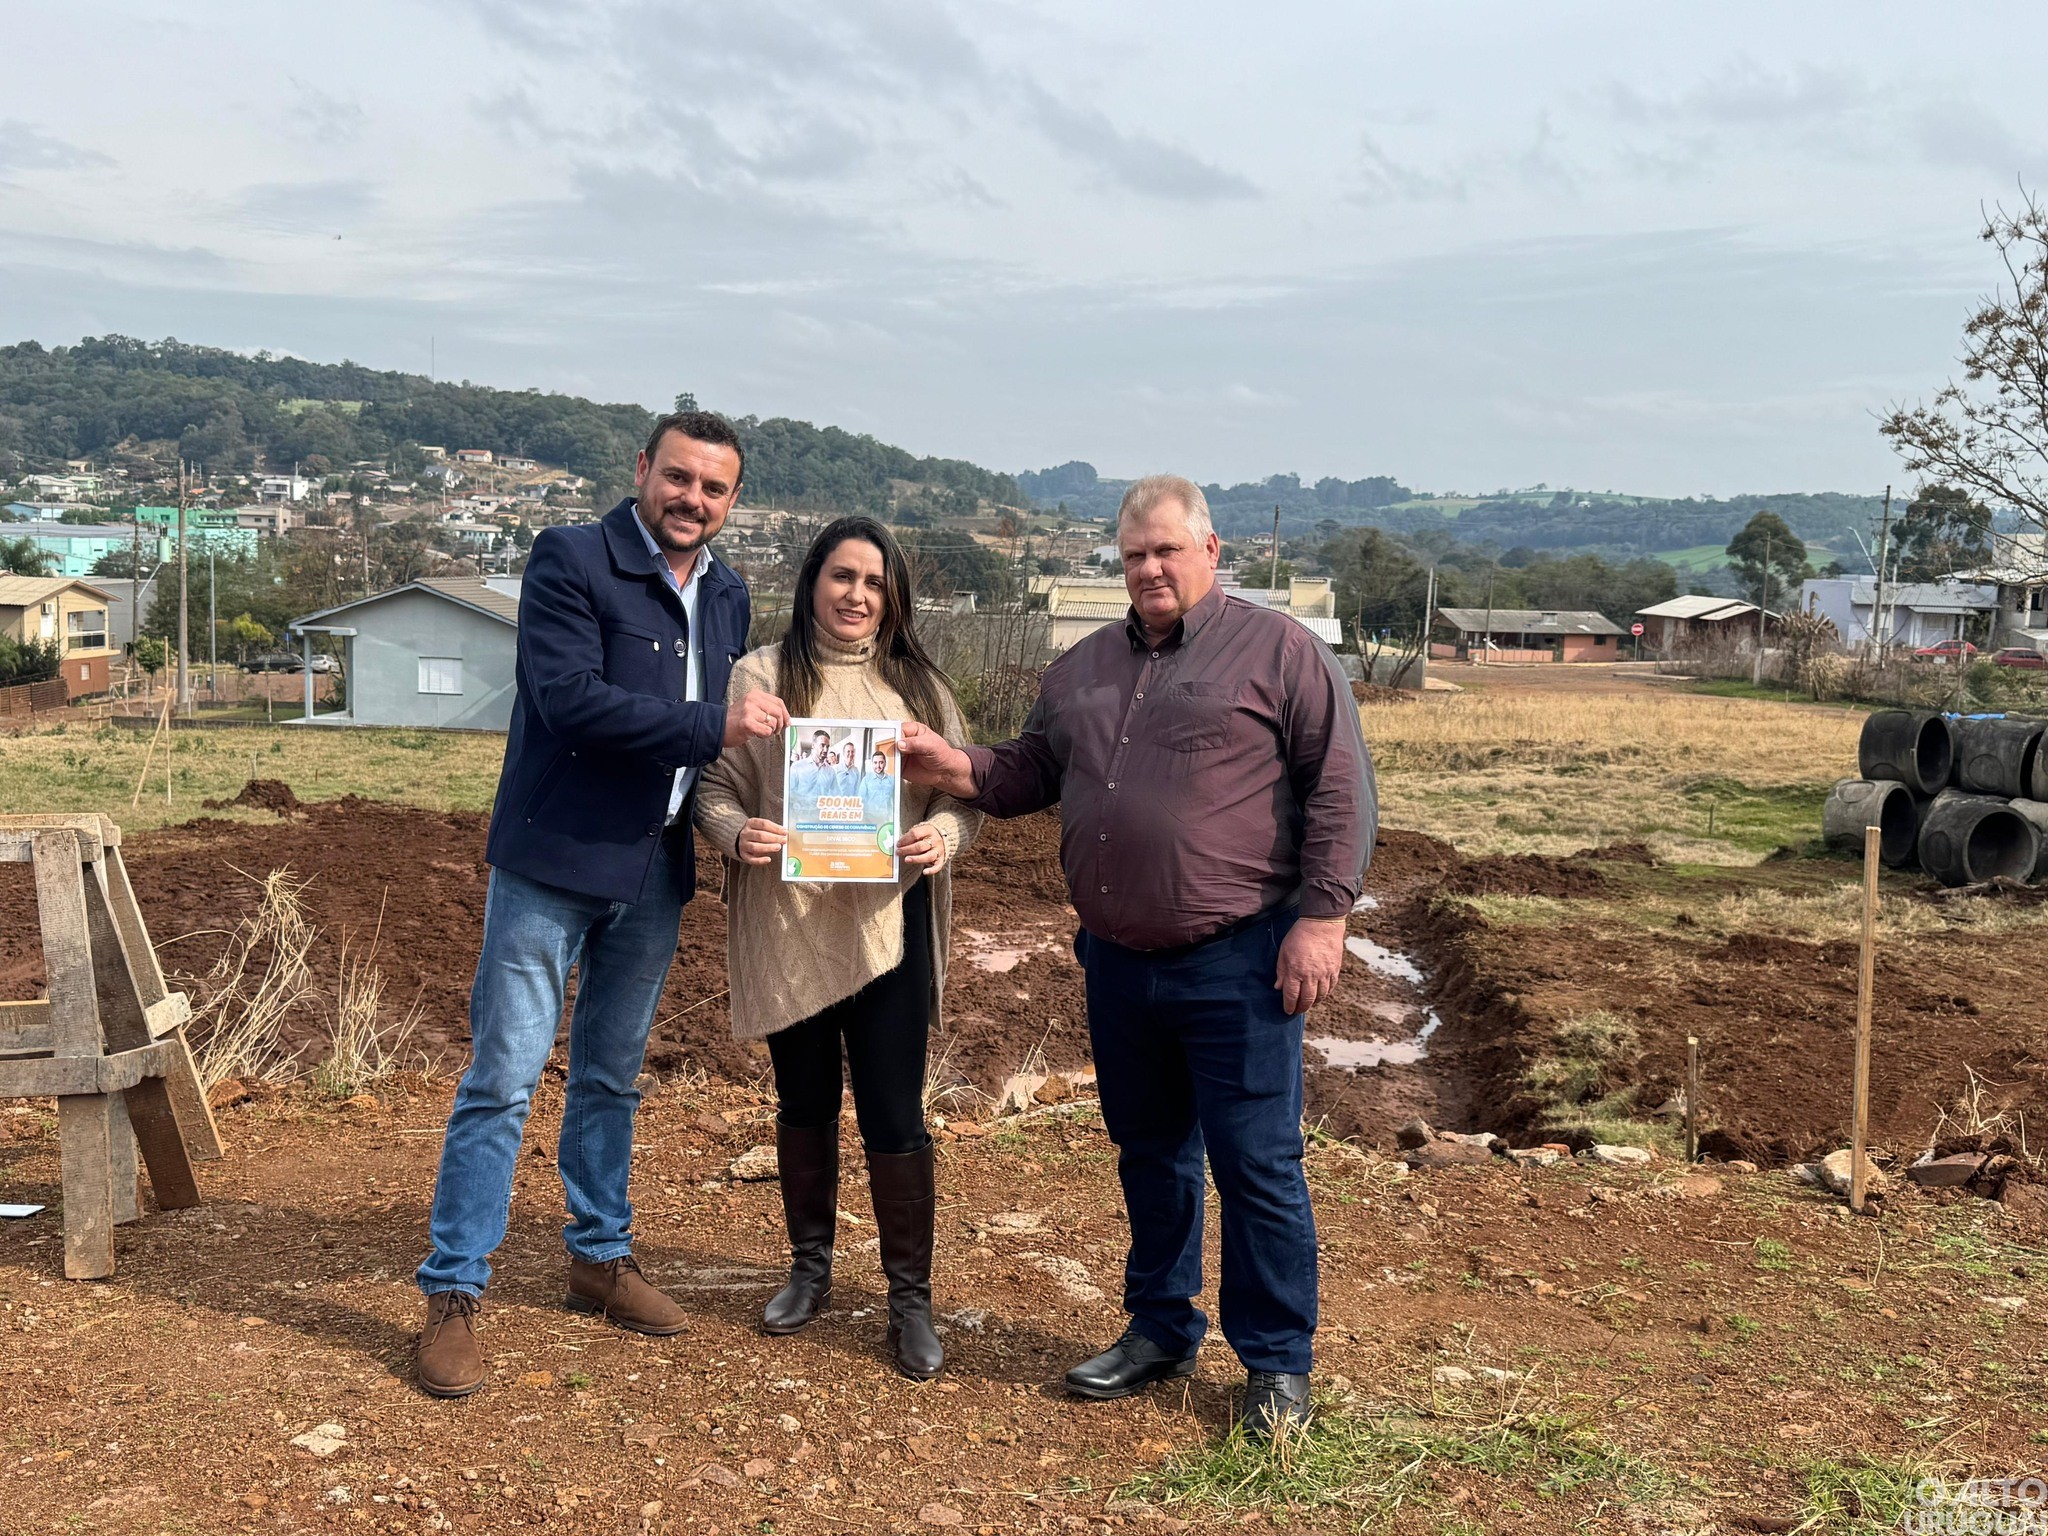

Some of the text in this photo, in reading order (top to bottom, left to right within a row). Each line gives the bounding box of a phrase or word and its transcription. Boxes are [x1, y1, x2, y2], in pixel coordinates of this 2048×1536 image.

[818, 797, 862, 808] 500 MIL
[820, 811, 862, 819] REAIS EM
